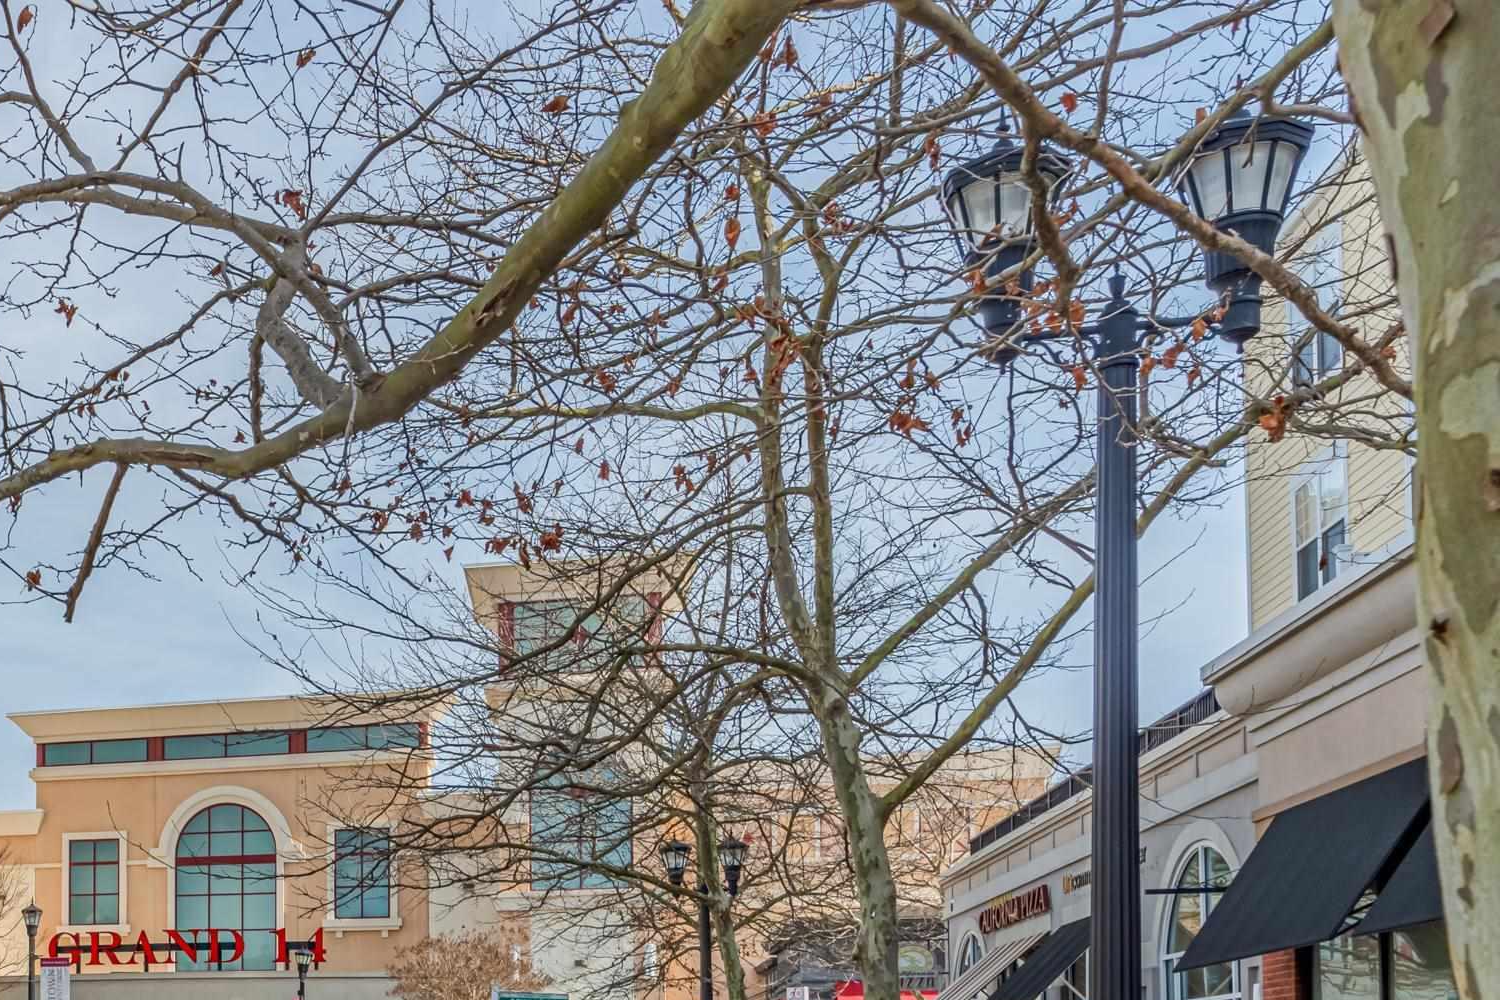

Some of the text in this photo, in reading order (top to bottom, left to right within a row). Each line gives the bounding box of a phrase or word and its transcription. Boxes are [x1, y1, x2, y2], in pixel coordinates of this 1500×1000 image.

[1020, 883, 1051, 921] PIZZA
[48, 927, 327, 966] GRAND 14
